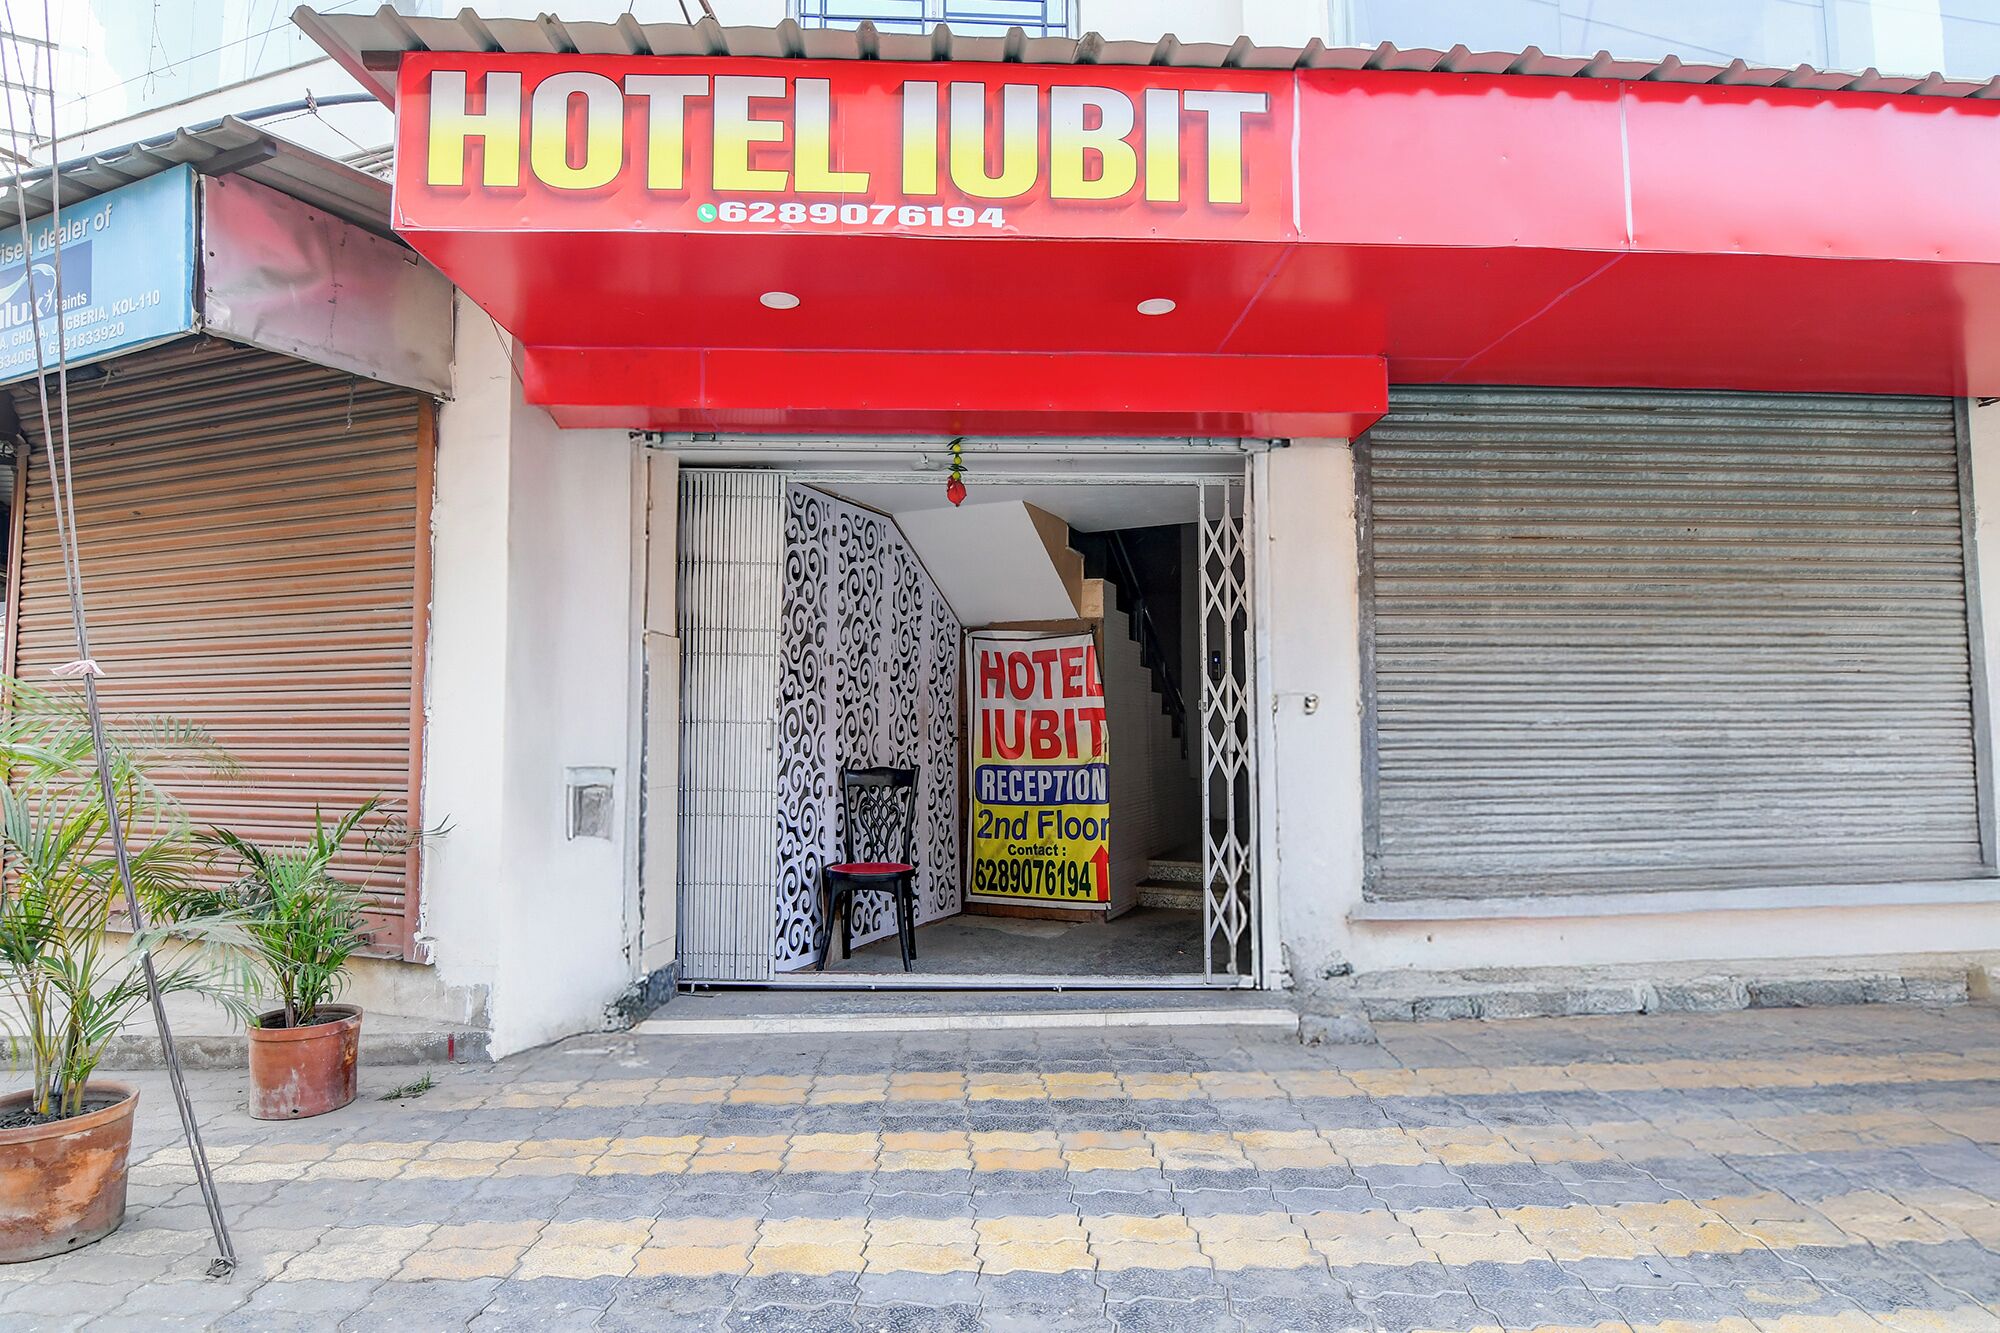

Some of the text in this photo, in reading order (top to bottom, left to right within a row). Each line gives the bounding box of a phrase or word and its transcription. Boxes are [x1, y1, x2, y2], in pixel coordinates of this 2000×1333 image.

[427, 69, 1269, 204] HOTEL IUBIT
[0, 202, 113, 265] ise dealer of
[718, 201, 1006, 228] 6289076194
[12, 324, 49, 347] GHOA,
[51, 305, 109, 336] JGBERIA,
[112, 289, 160, 317] KOL-110
[979, 644, 1105, 701] HOTEL
[981, 706, 1107, 760] IUBIT
[981, 767, 1107, 802] RECEPTION
[976, 808, 1110, 842] 2nd Floor
[1007, 843, 1059, 857] Contact
[975, 857, 1092, 898] 6289076194
